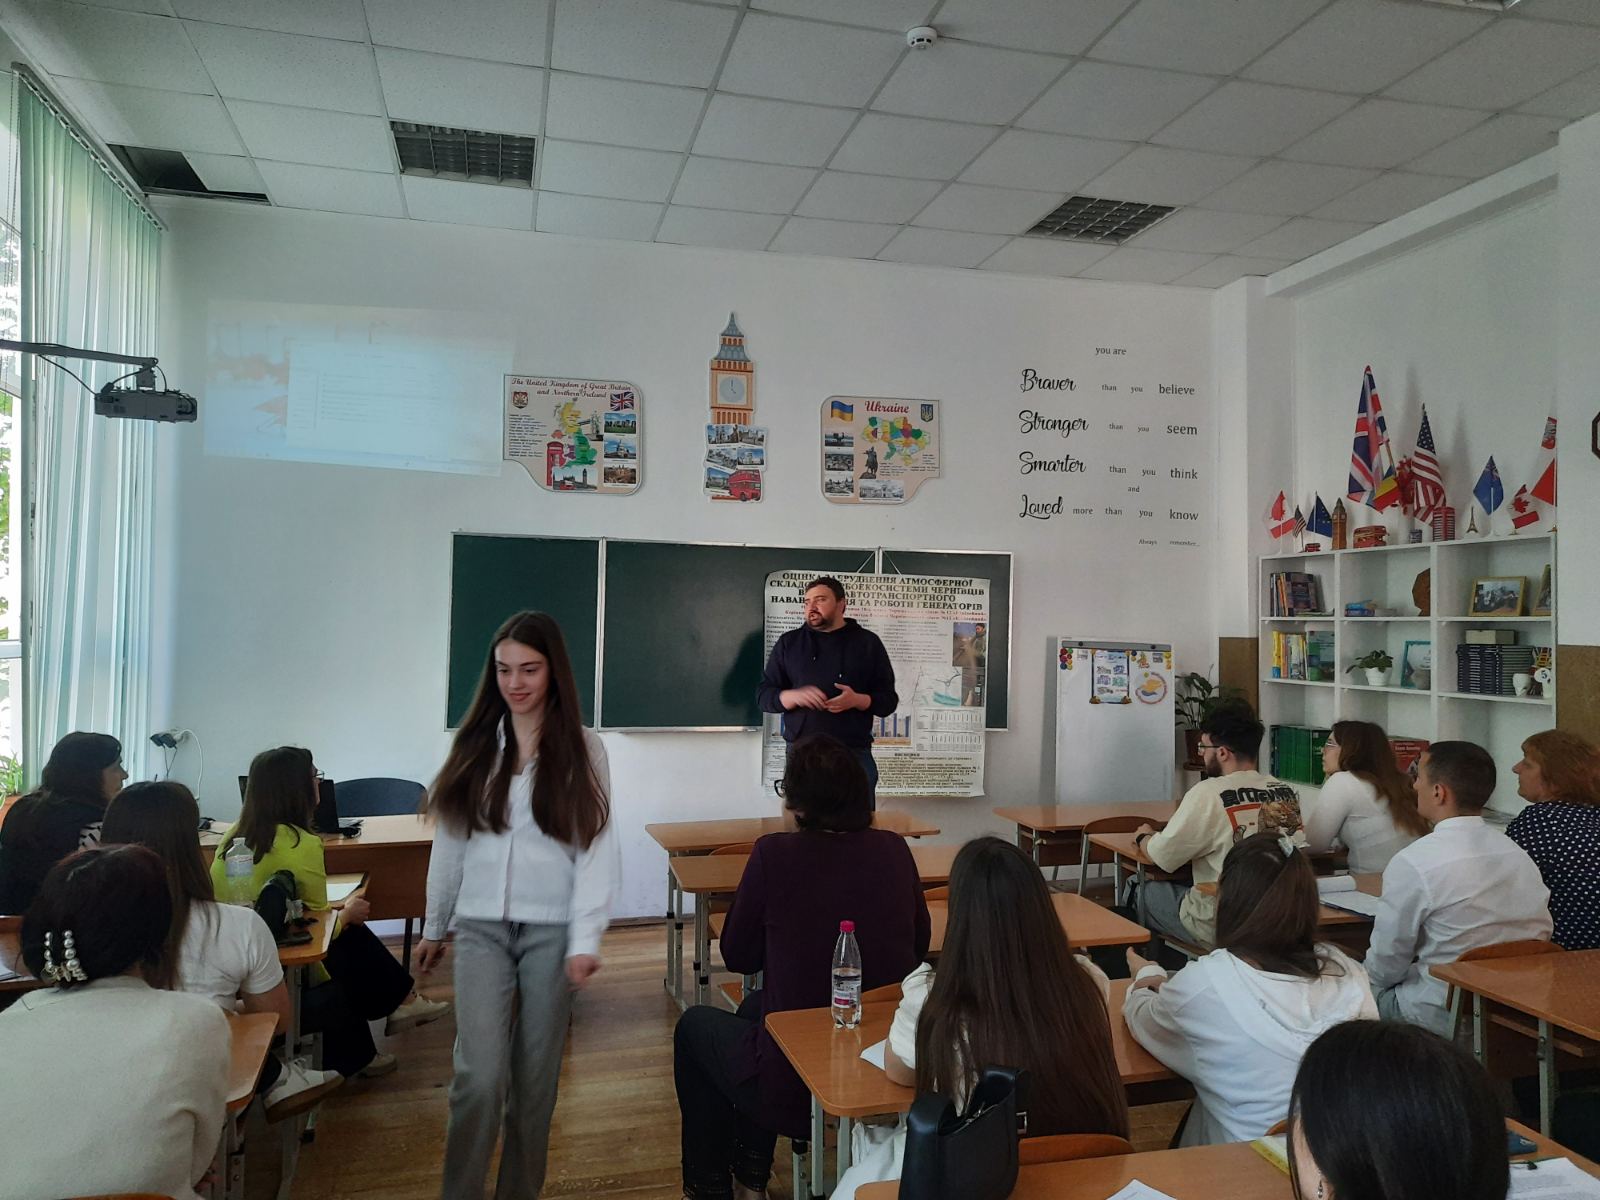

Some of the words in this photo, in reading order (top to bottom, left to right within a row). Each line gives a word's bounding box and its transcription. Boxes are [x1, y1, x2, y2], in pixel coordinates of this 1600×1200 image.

[1095, 346, 1111, 355] you
[1112, 347, 1127, 355] are
[526, 379, 548, 387] United
[549, 380, 580, 389] Kingdom
[580, 382, 588, 390] of
[1020, 368, 1076, 393] Braver
[1102, 384, 1117, 392] than
[1130, 385, 1143, 393] you
[1159, 384, 1195, 395] believe
[552, 389, 580, 397] Northern
[580, 389, 607, 398] Ireland
[864, 400, 910, 414] Ukraine
[1018, 410, 1089, 438] Stronger
[1109, 422, 1124, 430] than
[1137, 425, 1150, 433] you
[1166, 424, 1198, 435] seem
[1019, 451, 1086, 475] Smarter
[1109, 465, 1127, 474] than
[1142, 468, 1156, 476] you
[1170, 468, 1198, 480] think
[1127, 485, 1140, 493] and
[1019, 494, 1063, 520] Loved
[1072, 507, 1094, 515] more
[1105, 507, 1123, 516] than
[1139, 509, 1153, 518] you
[1169, 509, 1199, 520] know
[899, 577, 973, 587] АТМОСФЕРНОЇ
[931, 586, 985, 596] ЧЕРНІВЦІВ
[858, 599, 871, 607] ТА
[874, 600, 914, 608] РОБОТИ
[917, 601, 983, 611] ГЕНЕРАТОРІВ
